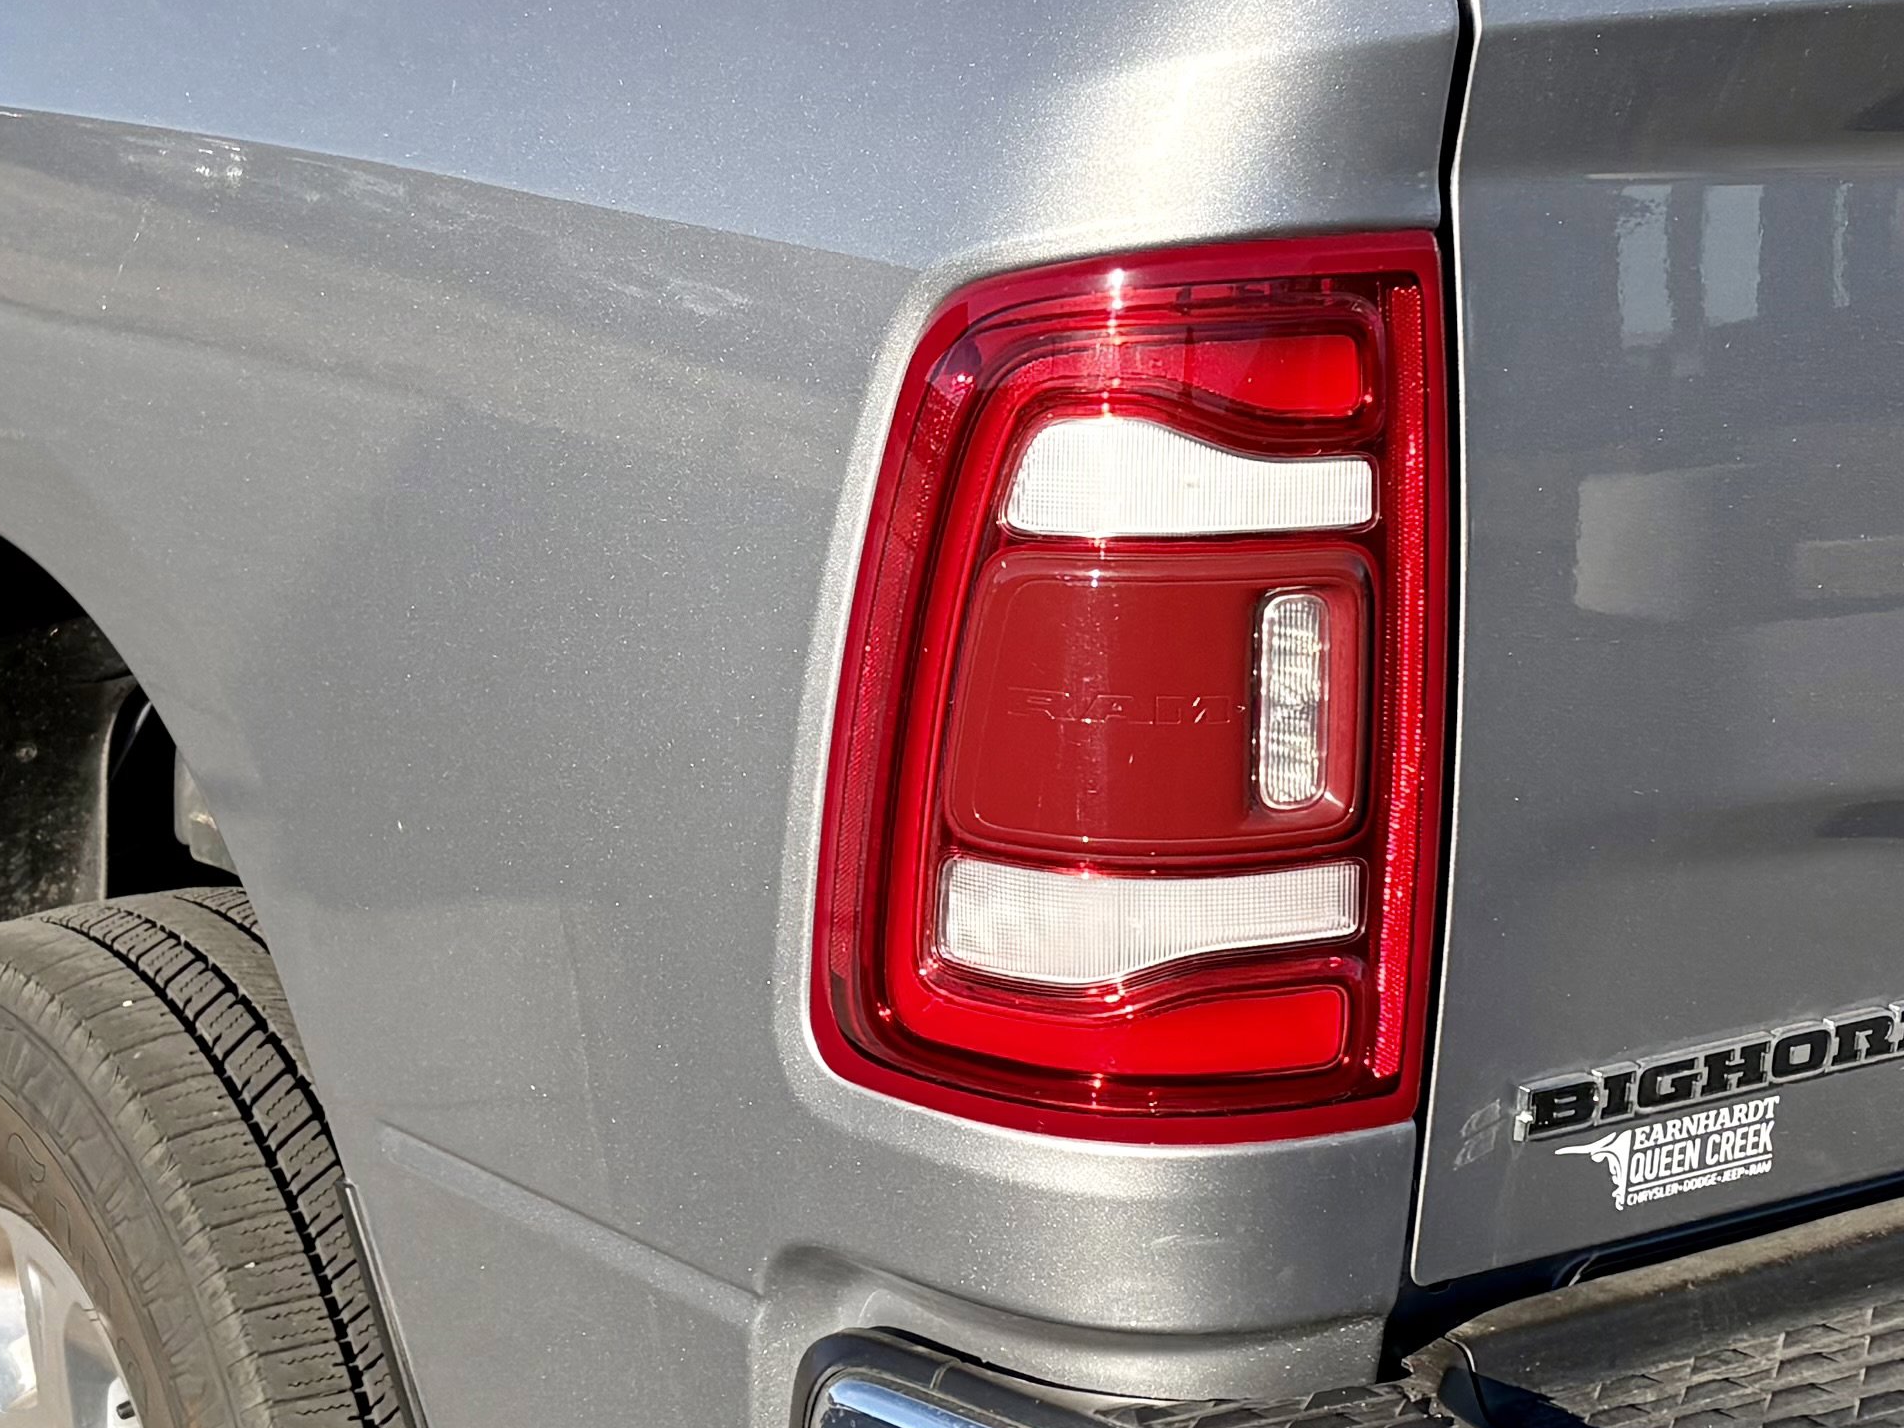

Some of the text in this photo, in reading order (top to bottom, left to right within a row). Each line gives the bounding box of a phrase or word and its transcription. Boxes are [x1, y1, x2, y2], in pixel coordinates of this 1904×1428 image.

[1629, 1121, 1776, 1184] QUEEN CREEK
[1633, 1095, 1781, 1151] EARNHARDT
